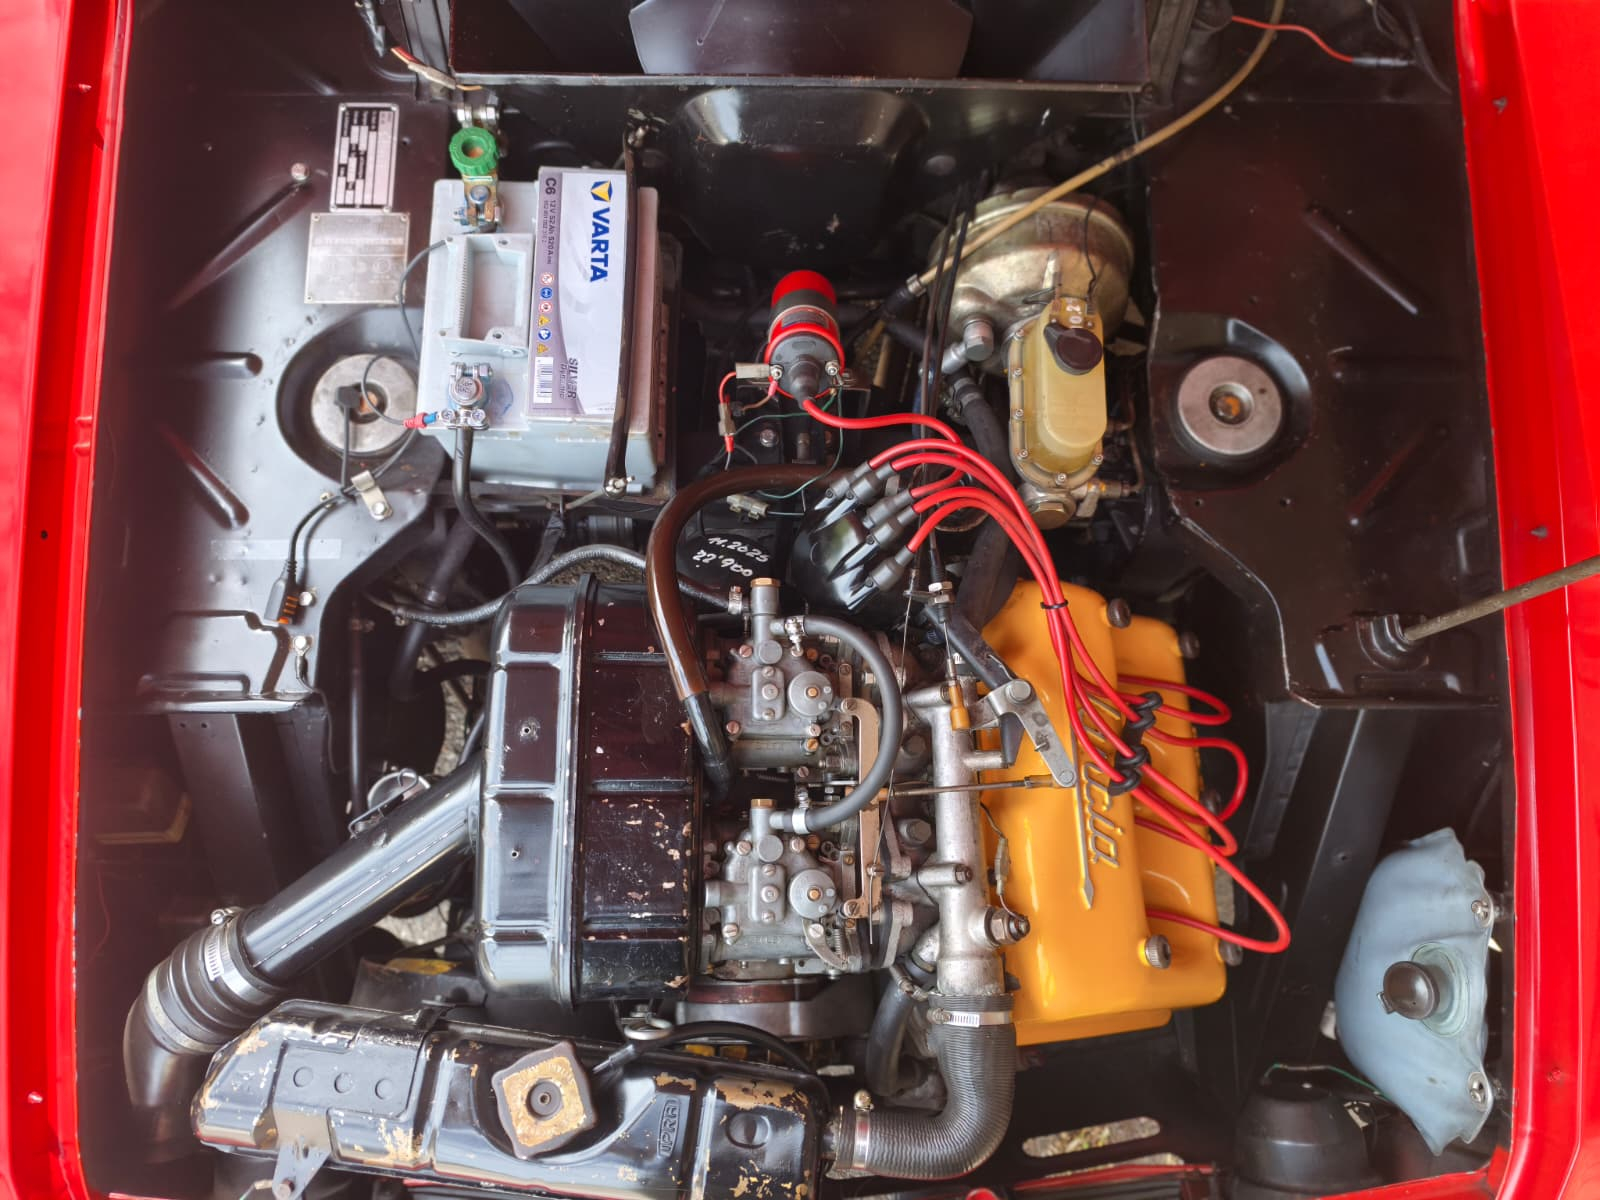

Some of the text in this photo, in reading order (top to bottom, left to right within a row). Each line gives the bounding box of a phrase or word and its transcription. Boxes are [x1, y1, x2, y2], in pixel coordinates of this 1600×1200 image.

[545, 177, 557, 195] C6
[590, 207, 610, 282] VARTA
[567, 357, 578, 399] SILVER
